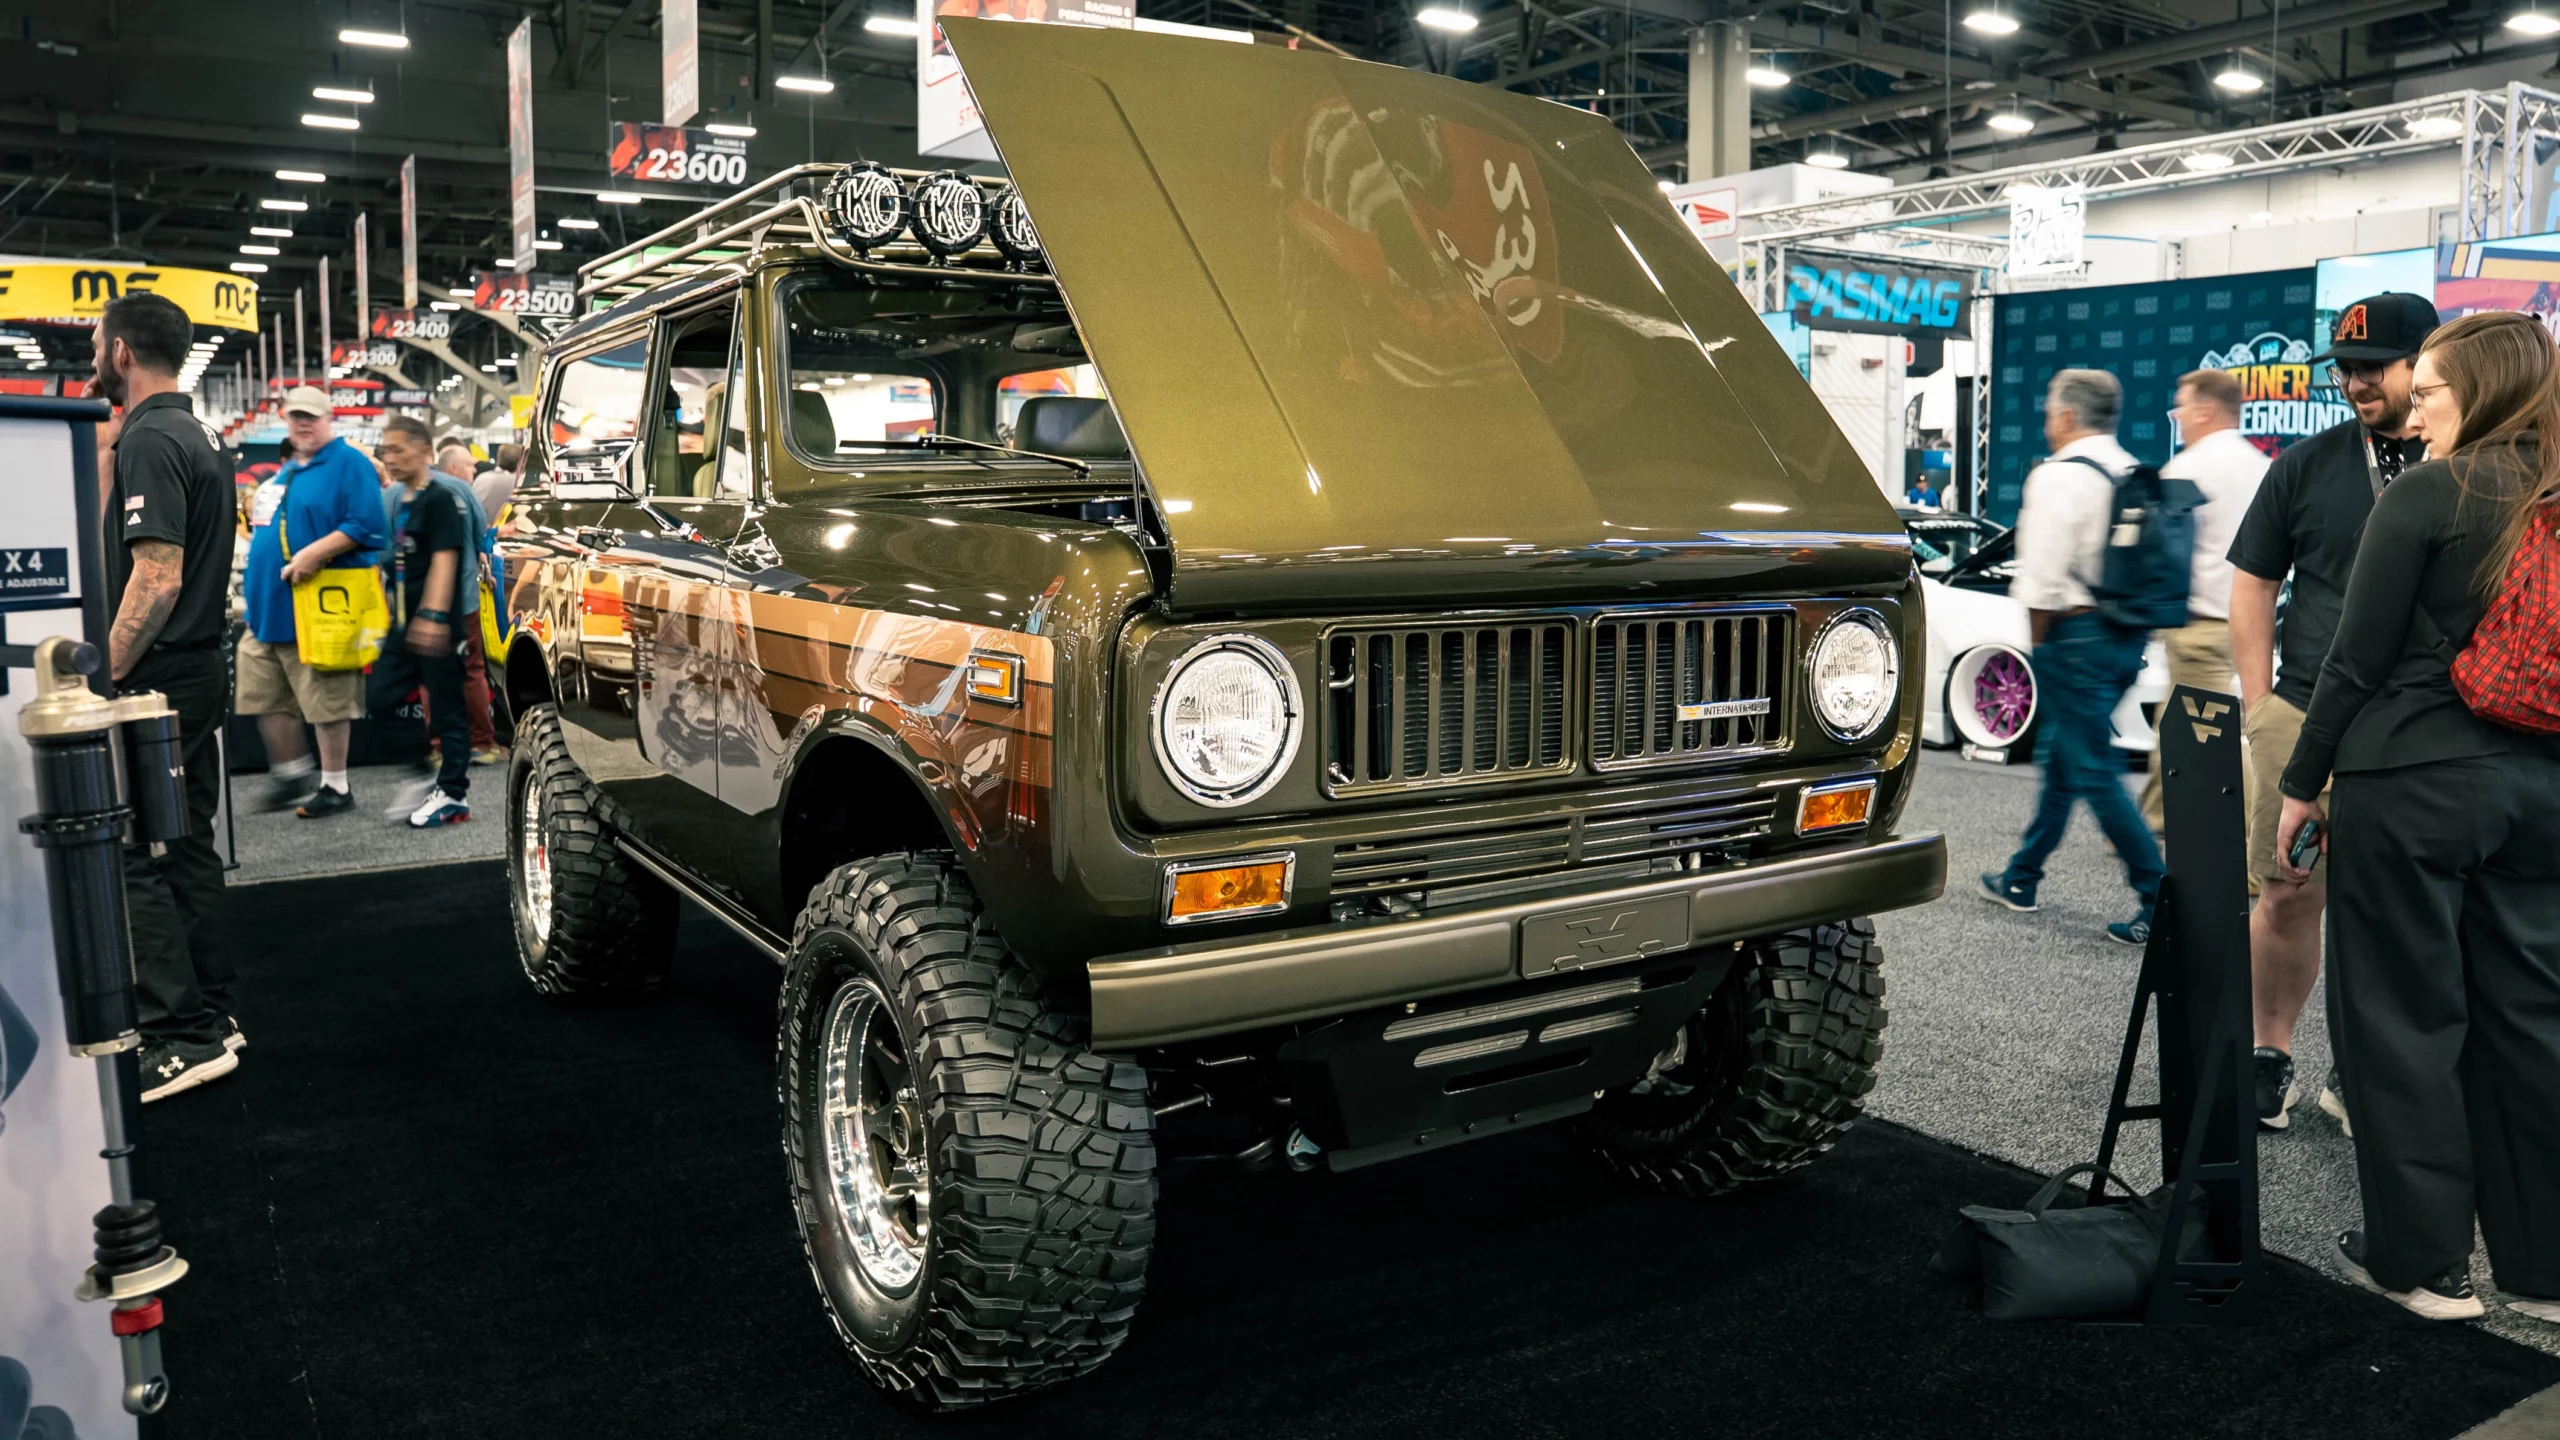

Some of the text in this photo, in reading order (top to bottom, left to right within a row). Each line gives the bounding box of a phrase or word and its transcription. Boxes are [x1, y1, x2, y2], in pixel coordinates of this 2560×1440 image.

[646, 148, 746, 185] 23600
[500, 289, 575, 314] 23500
[1786, 266, 1961, 329] PASMAG
[393, 319, 449, 338] 23400
[349, 350, 397, 366] 23300
[2227, 364, 2310, 401] TUNER
[4, 550, 43, 573] X 4
[6, 577, 66, 588] ADJUSTABLE
